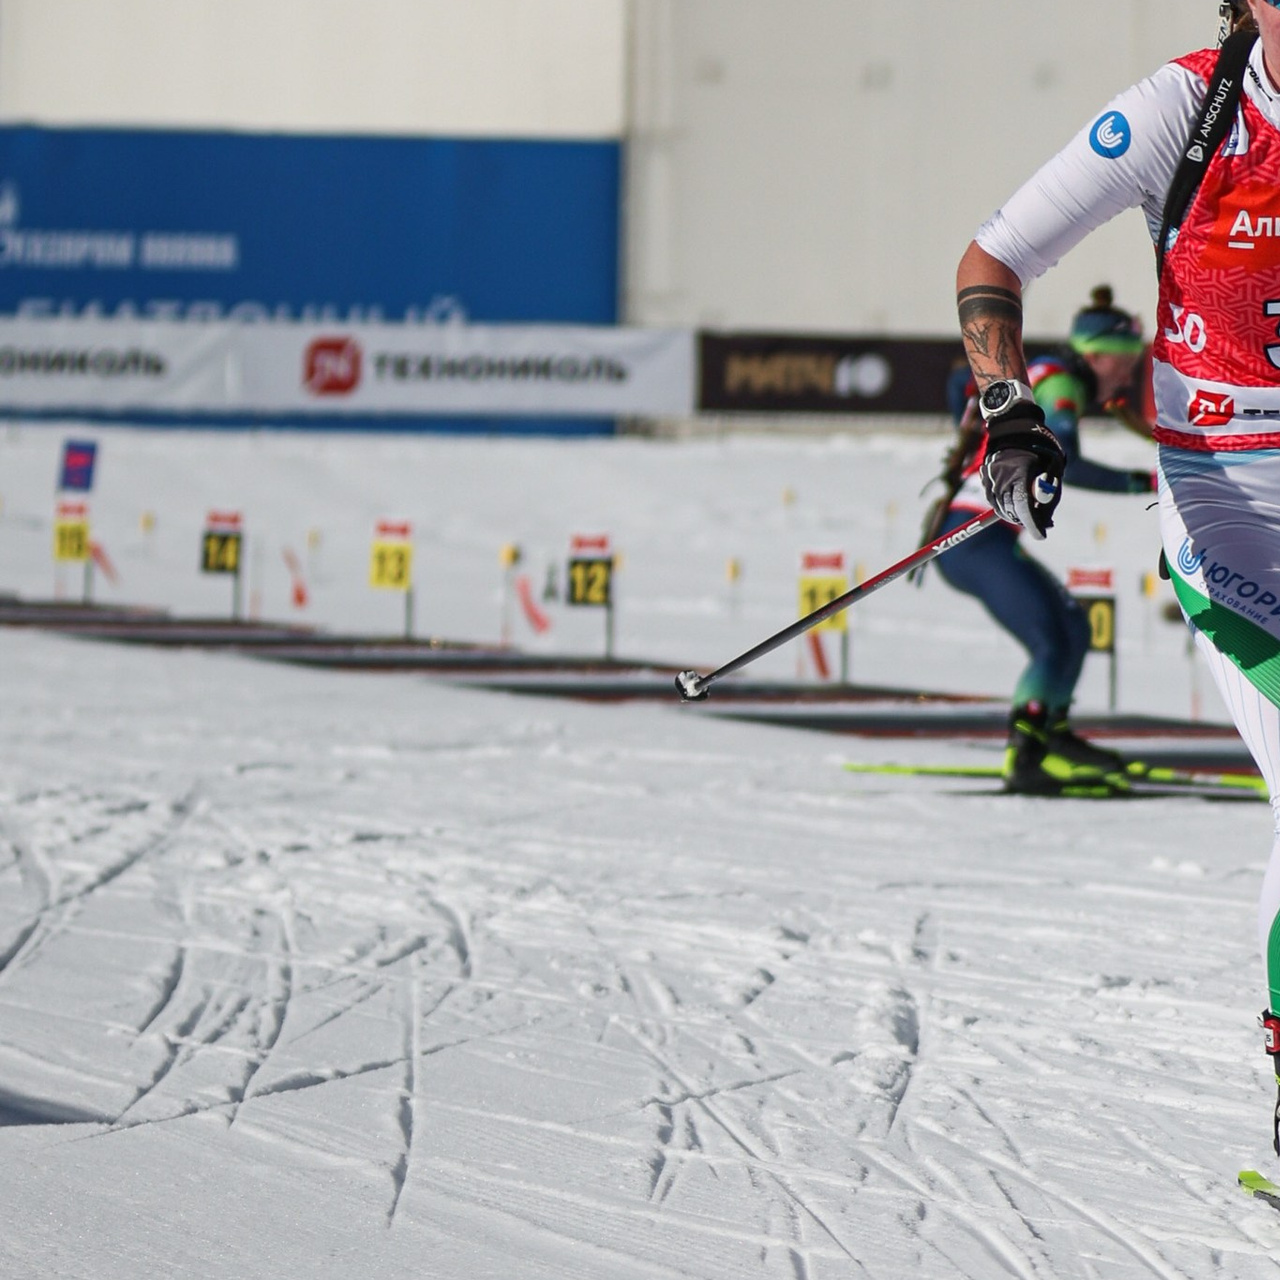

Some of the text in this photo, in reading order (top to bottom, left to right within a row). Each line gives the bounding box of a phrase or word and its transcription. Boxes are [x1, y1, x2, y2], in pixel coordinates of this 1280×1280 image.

[1163, 302, 1207, 354] 30
[571, 564, 607, 605] 12
[1200, 581, 1269, 625] СТРАХОВАНИЕ
